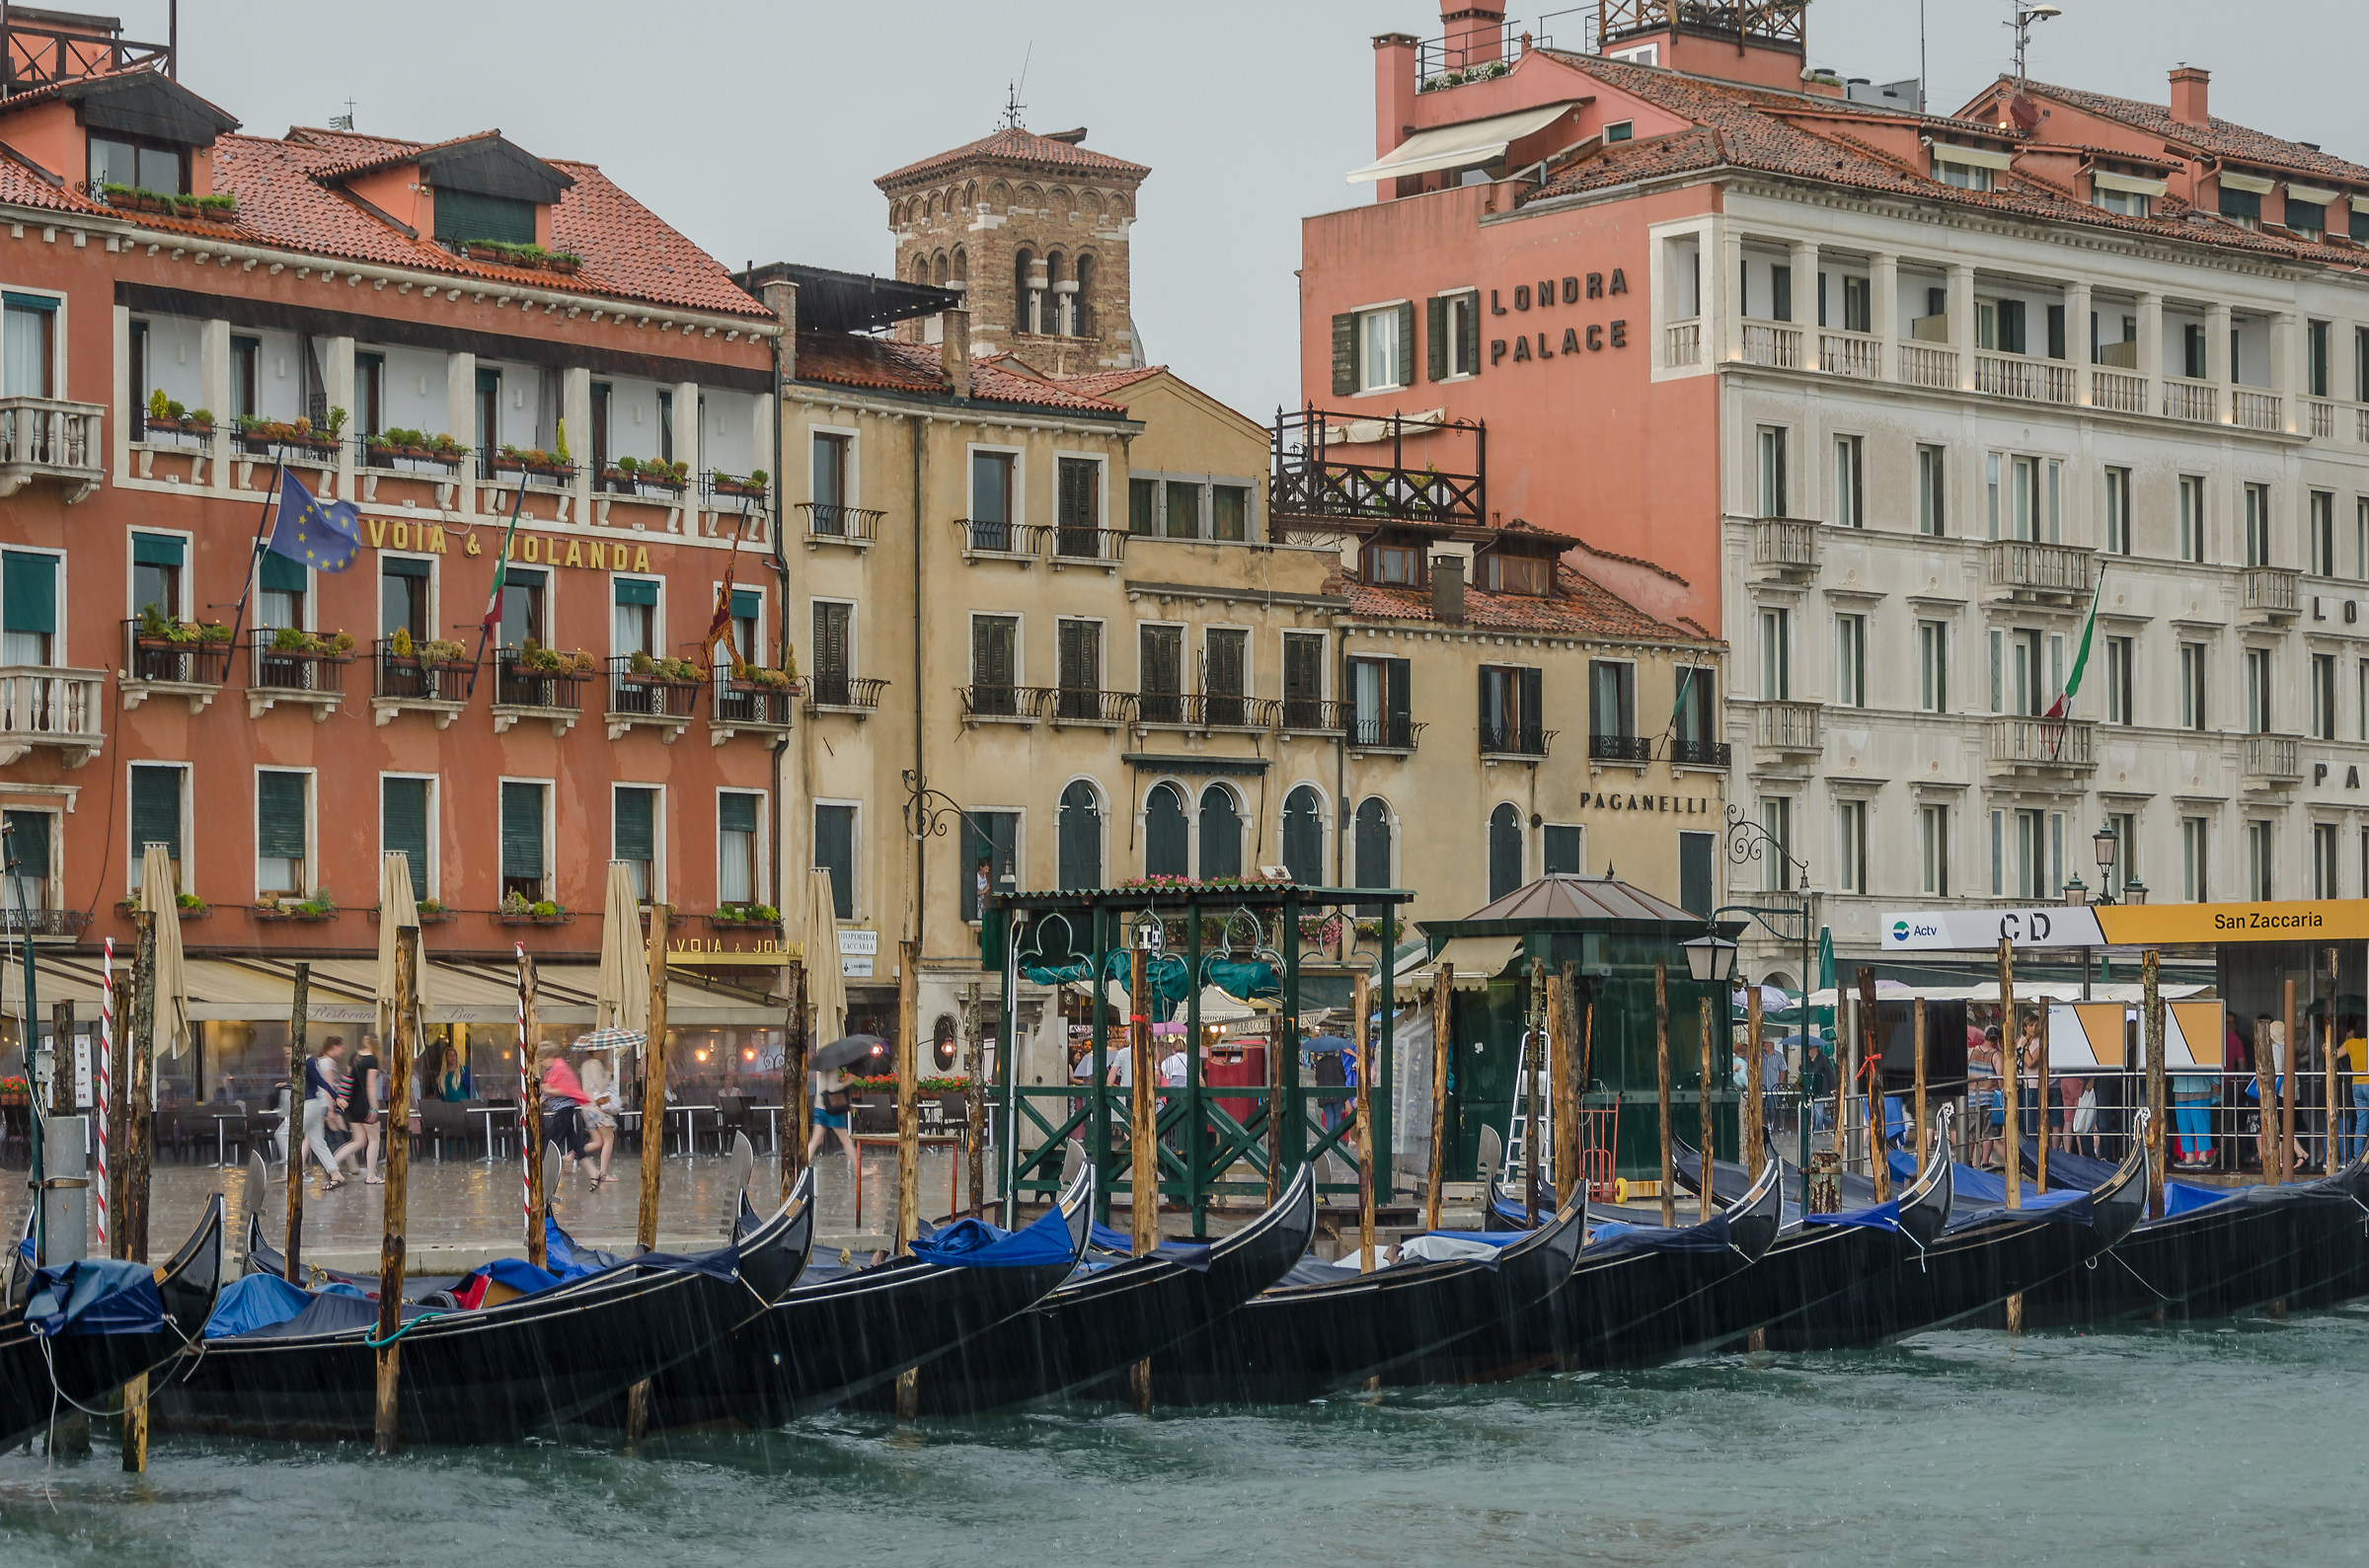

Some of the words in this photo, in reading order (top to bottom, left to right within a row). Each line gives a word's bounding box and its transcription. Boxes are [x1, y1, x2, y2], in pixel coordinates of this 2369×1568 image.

[1490, 267, 1627, 315] LONDRA
[1490, 319, 1626, 366] PALACE
[367, 518, 447, 555] VOIA
[466, 533, 482, 556] &
[1580, 792, 1707, 814] PAGANELLI
[2214, 914, 2246, 930] San
[2250, 912, 2323, 929] Zaccaria
[1913, 925, 1938, 936] Actv
[307, 1005, 377, 1019] Ristorant
[443, 1006, 479, 1019] Bar
[1235, 1018, 1270, 1032] TABACCH
